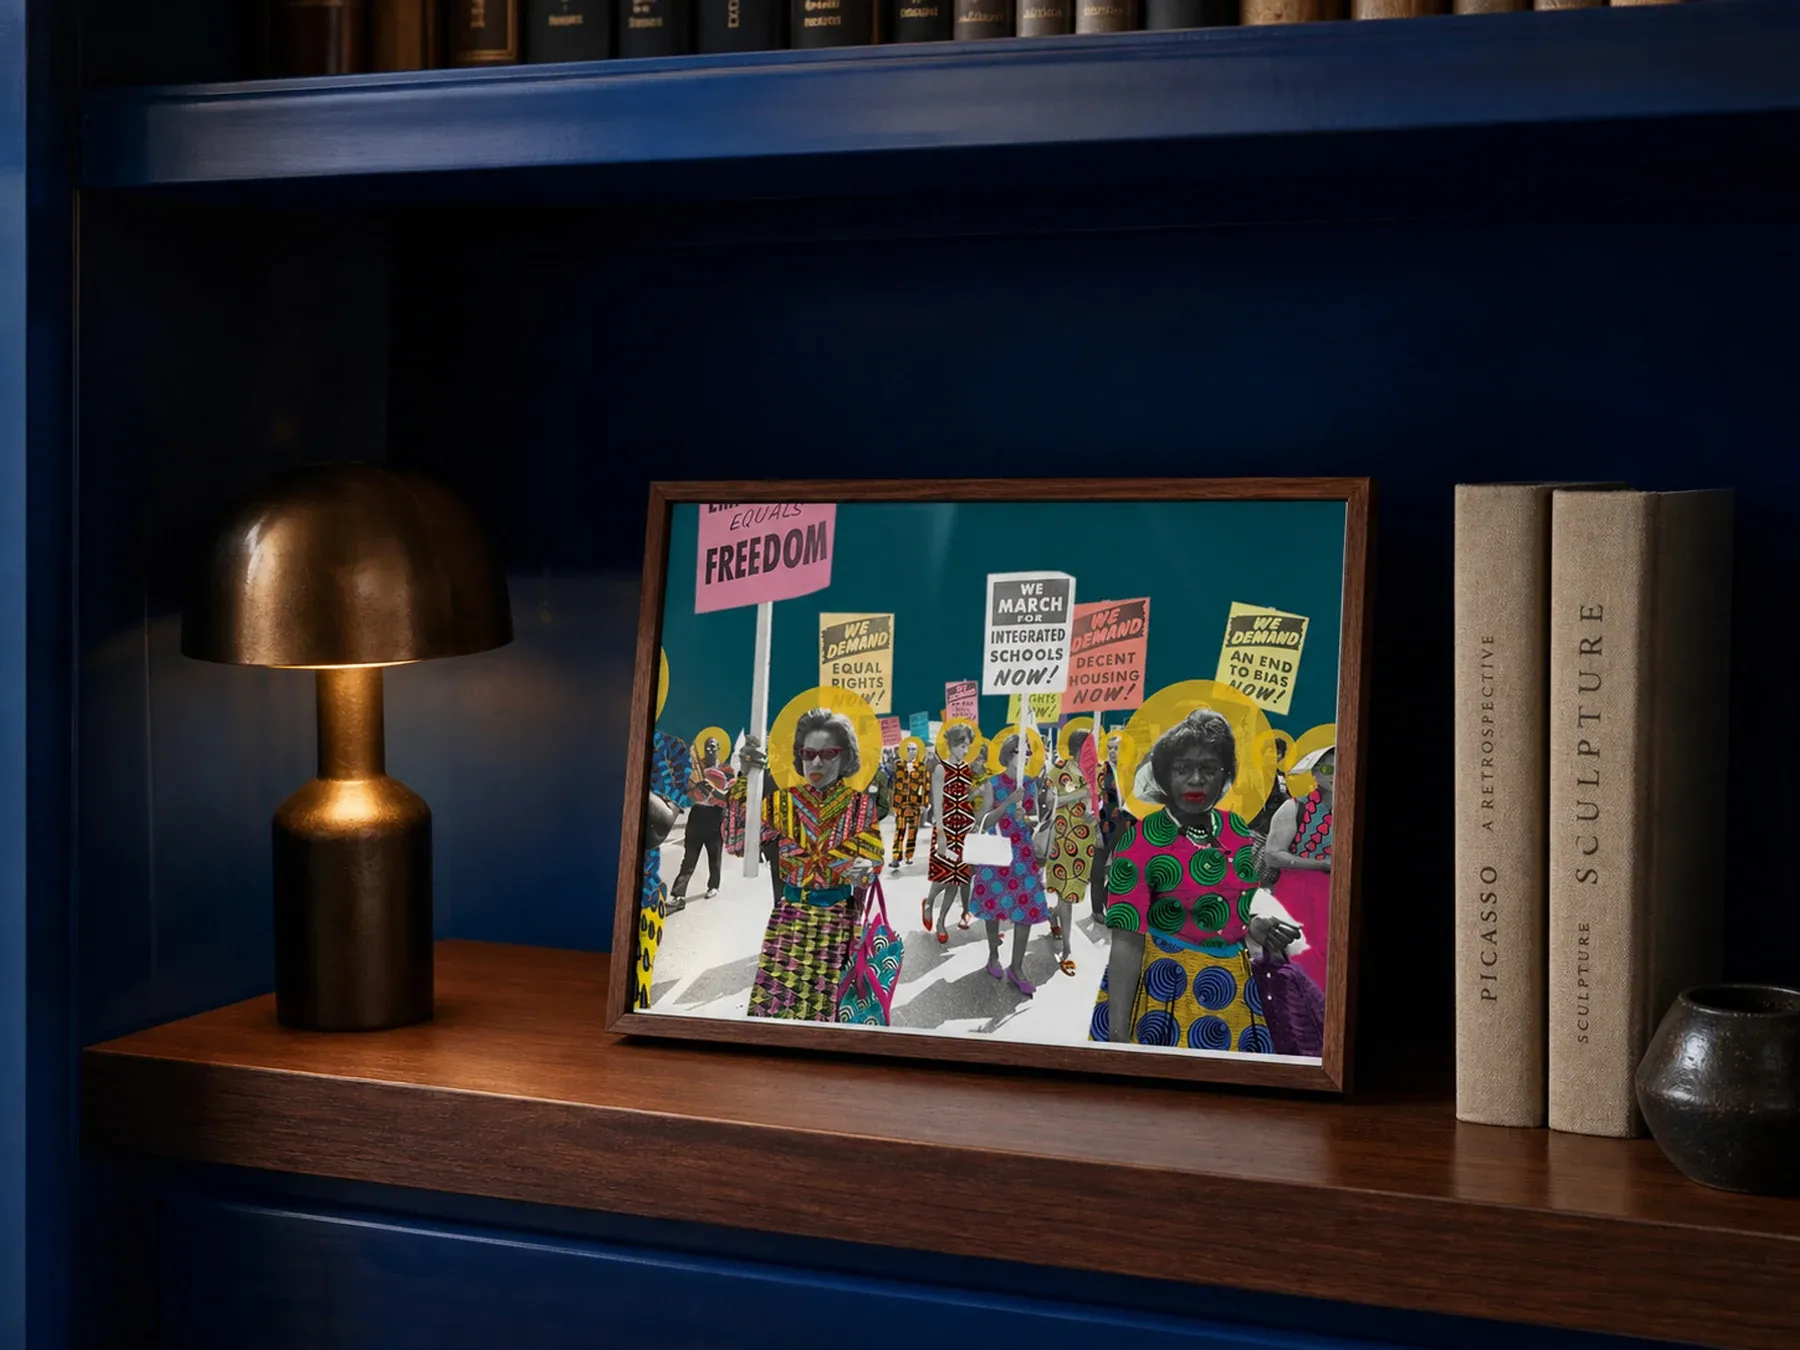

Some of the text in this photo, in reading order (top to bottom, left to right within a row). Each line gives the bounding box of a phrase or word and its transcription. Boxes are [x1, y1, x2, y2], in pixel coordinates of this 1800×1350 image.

[729, 503, 804, 531] EQUALS
[705, 520, 827, 585] FREEDOM
[1020, 583, 1043, 596] WE
[998, 596, 1063, 614] MARCH
[1017, 614, 1042, 623] FOR
[1091, 607, 1121, 630] WE
[1253, 616, 1282, 630] WE
[844, 621, 870, 639] WE
[991, 628, 1066, 644] INTEGRATED
[1071, 618, 1142, 653] DEMAND
[1231, 630, 1299, 646] DEMAND
[827, 632, 889, 659] DEMAND
[990, 648, 1063, 663] SCHOOLS
[832, 662, 882, 675] EQUAL
[1076, 652, 1136, 669] DECENT
[1230, 650, 1293, 673] AN END
[832, 676, 883, 689] RIGHTS
[993, 665, 1059, 687] NOW!
[1069, 670, 1140, 687] HOUSING
[1229, 664, 1289, 688] TO BIAS
[1073, 683, 1136, 705] NOW!
[1481, 634, 1495, 832] A RETROSPECTIVE
[1576, 602, 1604, 885] SCULPTURE
[1480, 864, 1498, 1002] PICASSO
[1577, 921, 1590, 1045] SCULPTURE
